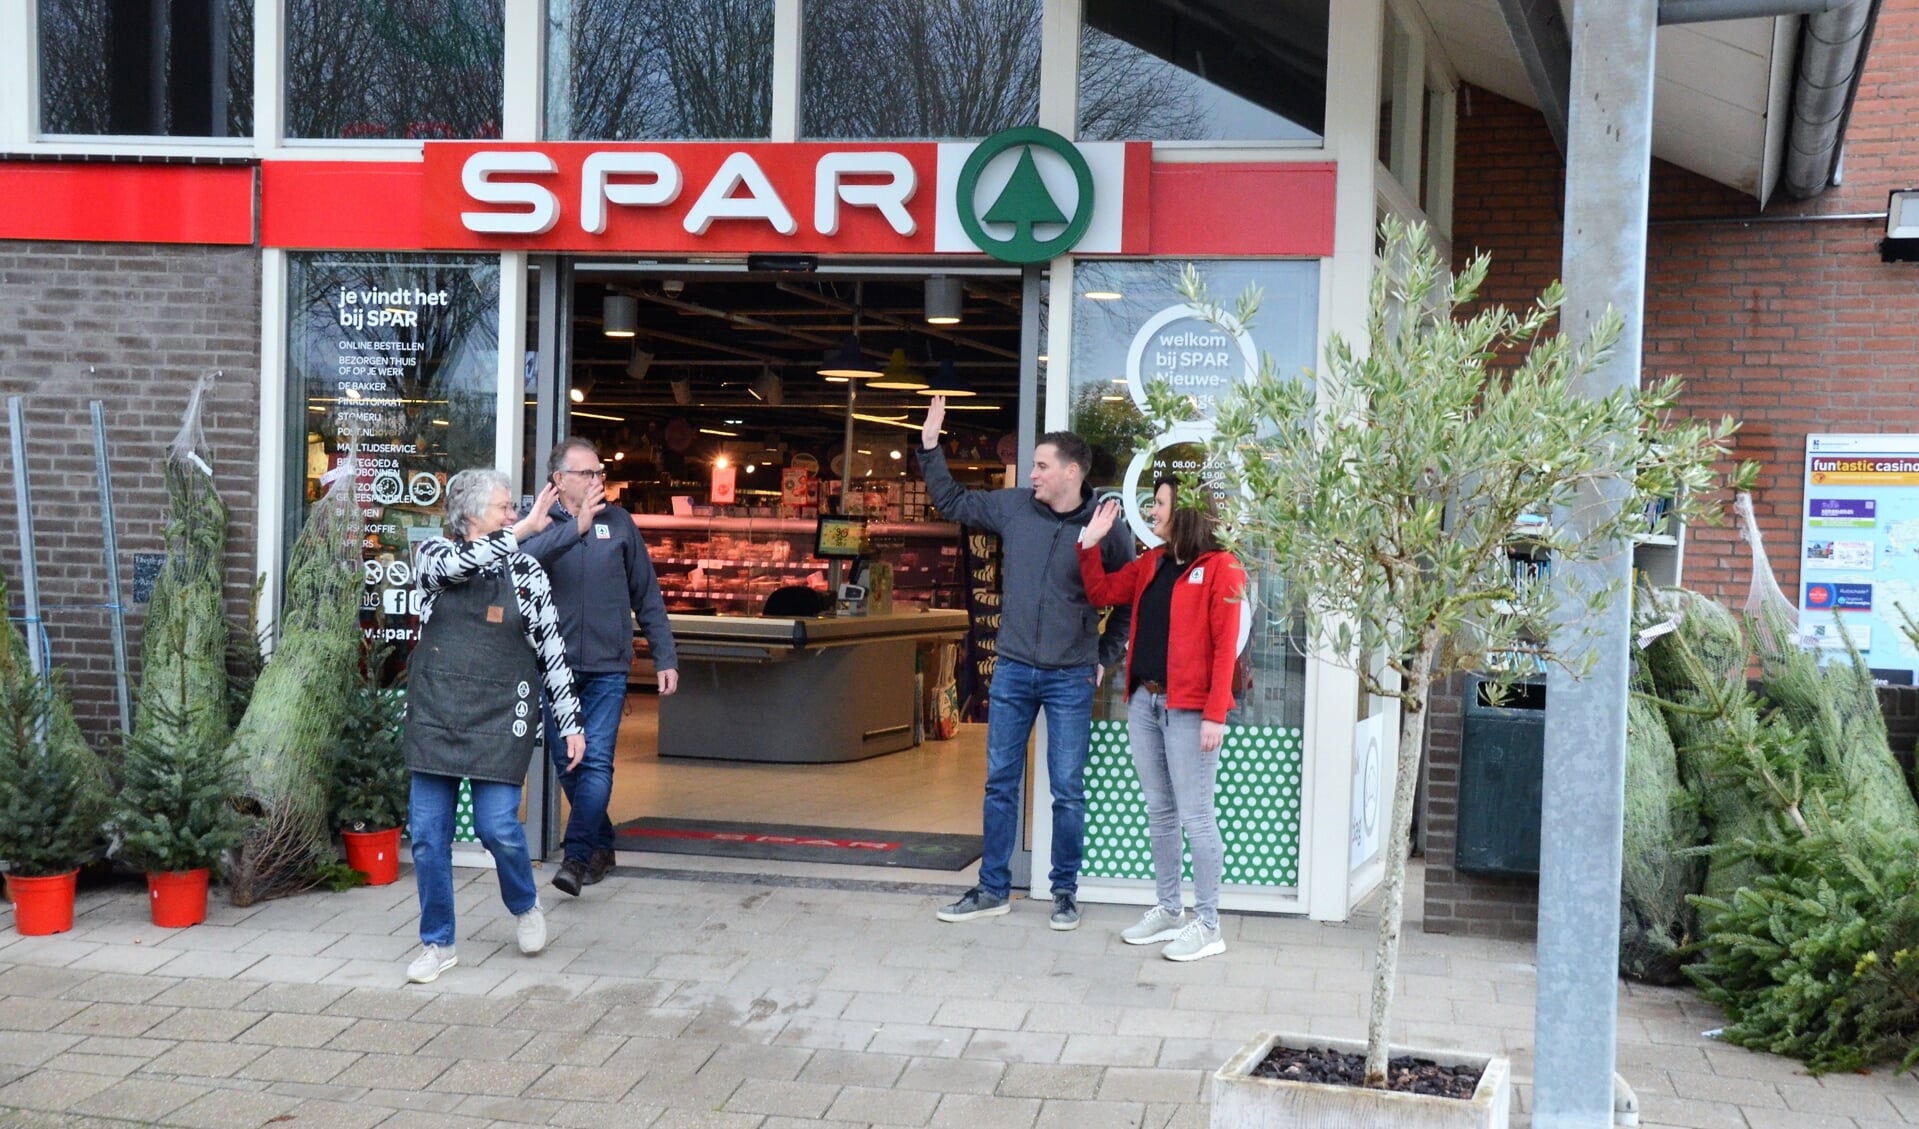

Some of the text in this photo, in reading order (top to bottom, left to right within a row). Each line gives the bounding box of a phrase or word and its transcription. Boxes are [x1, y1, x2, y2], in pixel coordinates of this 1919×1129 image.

[461, 150, 918, 237] SPAR
[338, 286, 448, 308] je vindt het
[340, 308, 418, 330] bij SPAR
[1160, 331, 1226, 347] welkom
[338, 341, 425, 351] ONLINE BESTELLEN
[338, 356, 417, 366] BEZORGEN THUIS
[1156, 351, 1229, 370] bij SPAR
[338, 366, 404, 377] OF OP JE WERK
[338, 381, 387, 391] DE BAKKER
[338, 396, 403, 407] PINAUTOMAAT
[337, 443, 417, 454] MALTIJDSERVICE
[1153, 460, 1167, 468] MA
[1172, 460, 1197, 469] 08.00
[1813, 459, 1875, 472] funtastic
[364, 524, 396, 534] KOFFIE
